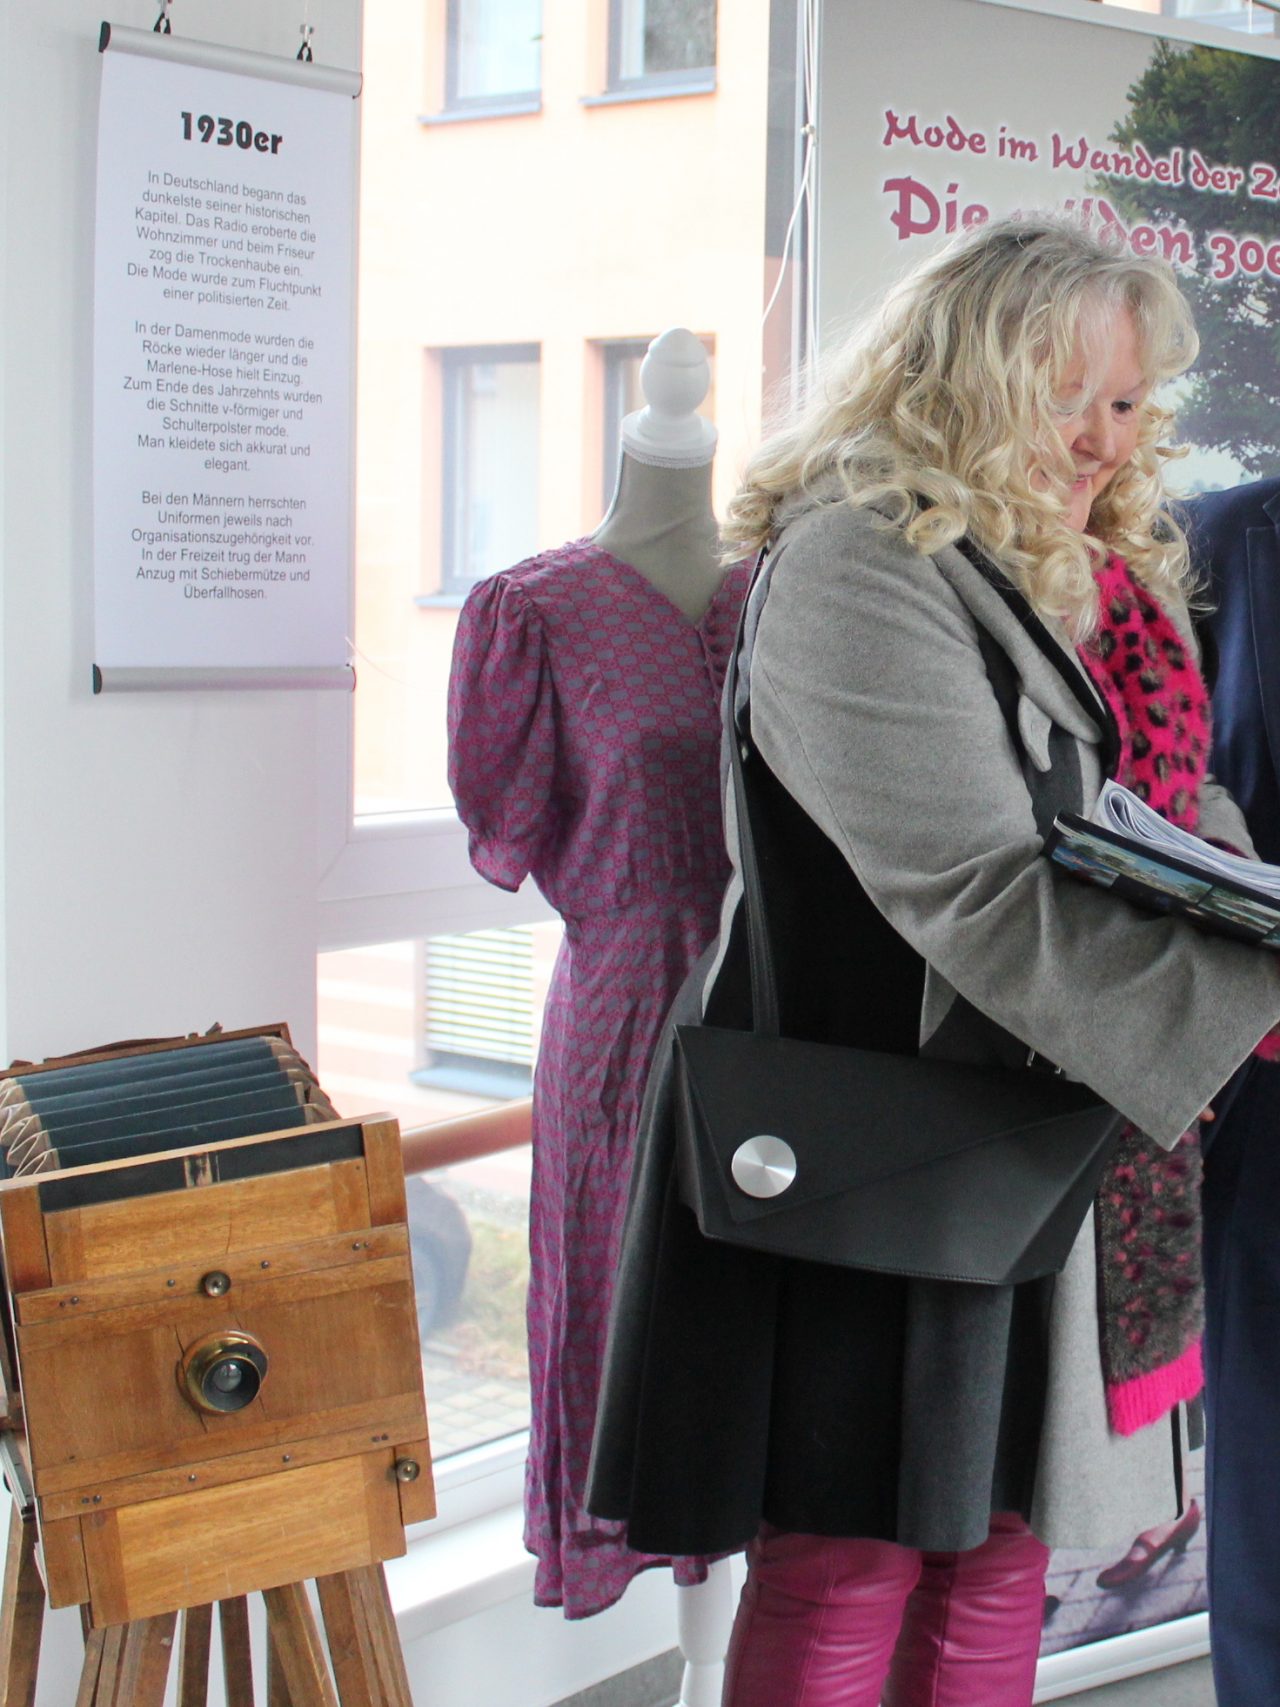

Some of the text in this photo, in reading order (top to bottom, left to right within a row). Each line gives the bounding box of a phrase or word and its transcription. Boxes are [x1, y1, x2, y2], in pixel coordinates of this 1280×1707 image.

[181, 111, 283, 154] 1930er
[883, 110, 986, 154] Mode
[999, 127, 1039, 162] im
[1052, 134, 1181, 184] Wandel
[1192, 154, 1242, 191] der
[147, 169, 306, 205] In Deutschland begann das
[141, 188, 310, 224] dunkelste seiner historischen
[883, 175, 989, 240] Die
[134, 206, 316, 243] Kapitel. Das Radio eroberte die
[136, 225, 315, 260] Wohnzimmer und beim Friseur
[148, 248, 303, 277] zog die Trockenhaube ein.
[127, 262, 321, 296] Die Mode wurde zum Fluchtpunkt
[162, 286, 290, 311] einer politisierten Zeit.
[134, 320, 313, 349] In der Damenmode wurden die
[142, 339, 308, 367] Röcke wieder länger und die
[146, 358, 303, 387] Marlene-Hose hielt Einzug.
[122, 375, 322, 403] Zum Ende des Jahrzehnts wurden
[146, 396, 302, 421] die Schnitte v-förmiger und
[162, 415, 289, 437] Schulterpolster mode.
[137, 433, 310, 456] Man kleidete sich akkurat und
[203, 456, 251, 473] elegant.
[141, 490, 306, 509] Bei den Männern herrschten
[157, 509, 292, 528] Uniformen jeweils nach
[130, 527, 314, 548] Organisationszugehörigkeit vor.
[141, 546, 306, 566] In der Freizeit trug der Mann
[135, 565, 310, 583] Anzug mit Schiebermütze und
[183, 582, 267, 600] Überfallhosen.
